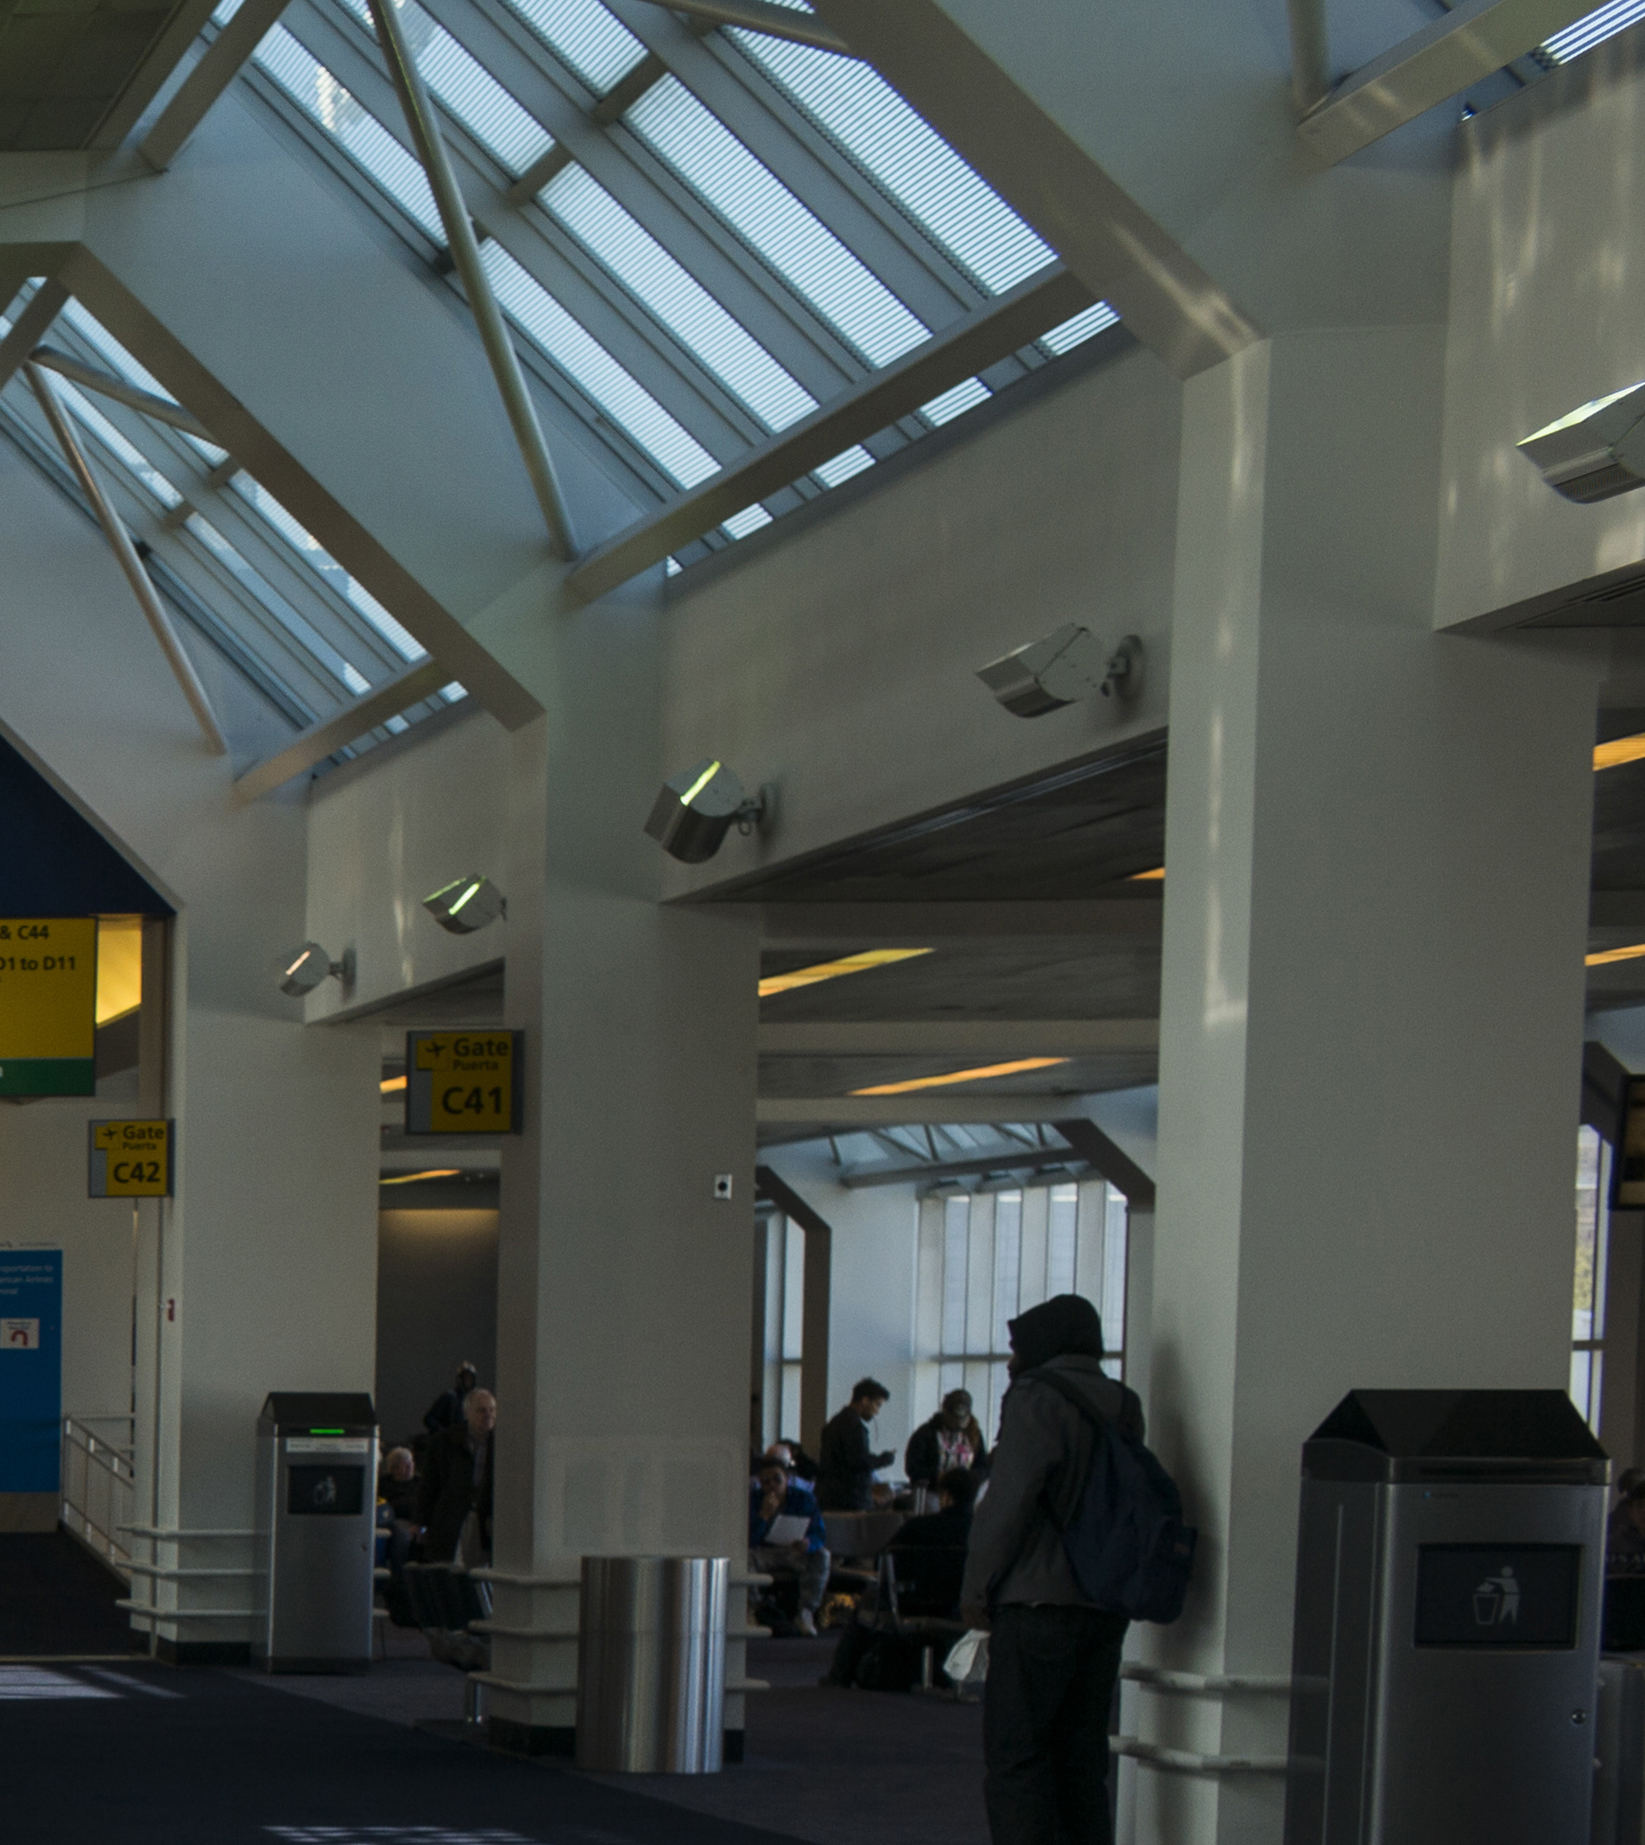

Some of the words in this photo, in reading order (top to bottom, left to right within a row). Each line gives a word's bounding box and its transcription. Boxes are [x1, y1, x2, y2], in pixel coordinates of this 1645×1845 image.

[0, 925, 11, 940] &
[17, 925, 49, 940] C44
[20, 957, 38, 971] to
[43, 955, 76, 970] D11
[453, 1038, 509, 1057] Gate
[442, 1085, 502, 1115] C41
[122, 1125, 165, 1140] Gate
[113, 1161, 161, 1184] C42
